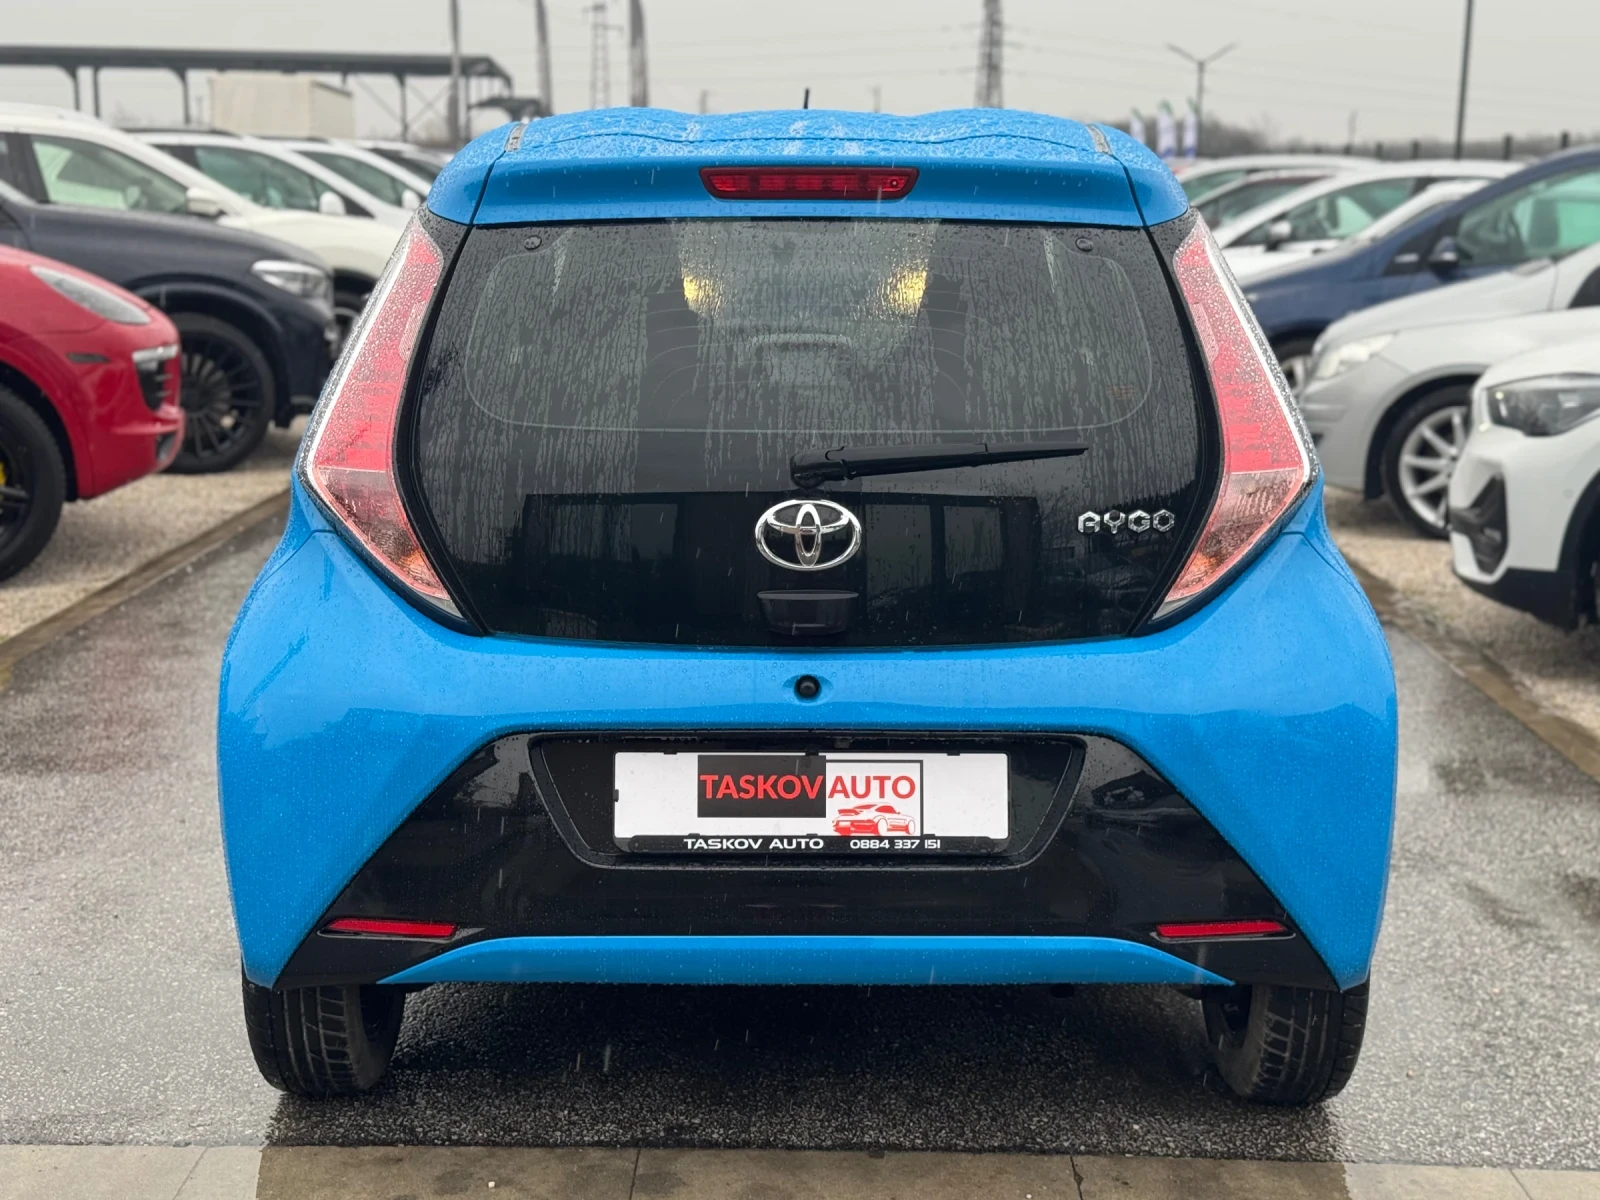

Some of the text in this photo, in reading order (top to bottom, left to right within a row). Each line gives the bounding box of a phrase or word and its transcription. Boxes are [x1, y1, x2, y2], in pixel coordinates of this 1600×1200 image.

[1078, 509, 1175, 534] AYGO
[700, 774, 916, 800] TASKOV AUTO
[684, 838, 941, 850] TASKOV AUTO 0884 337 151
